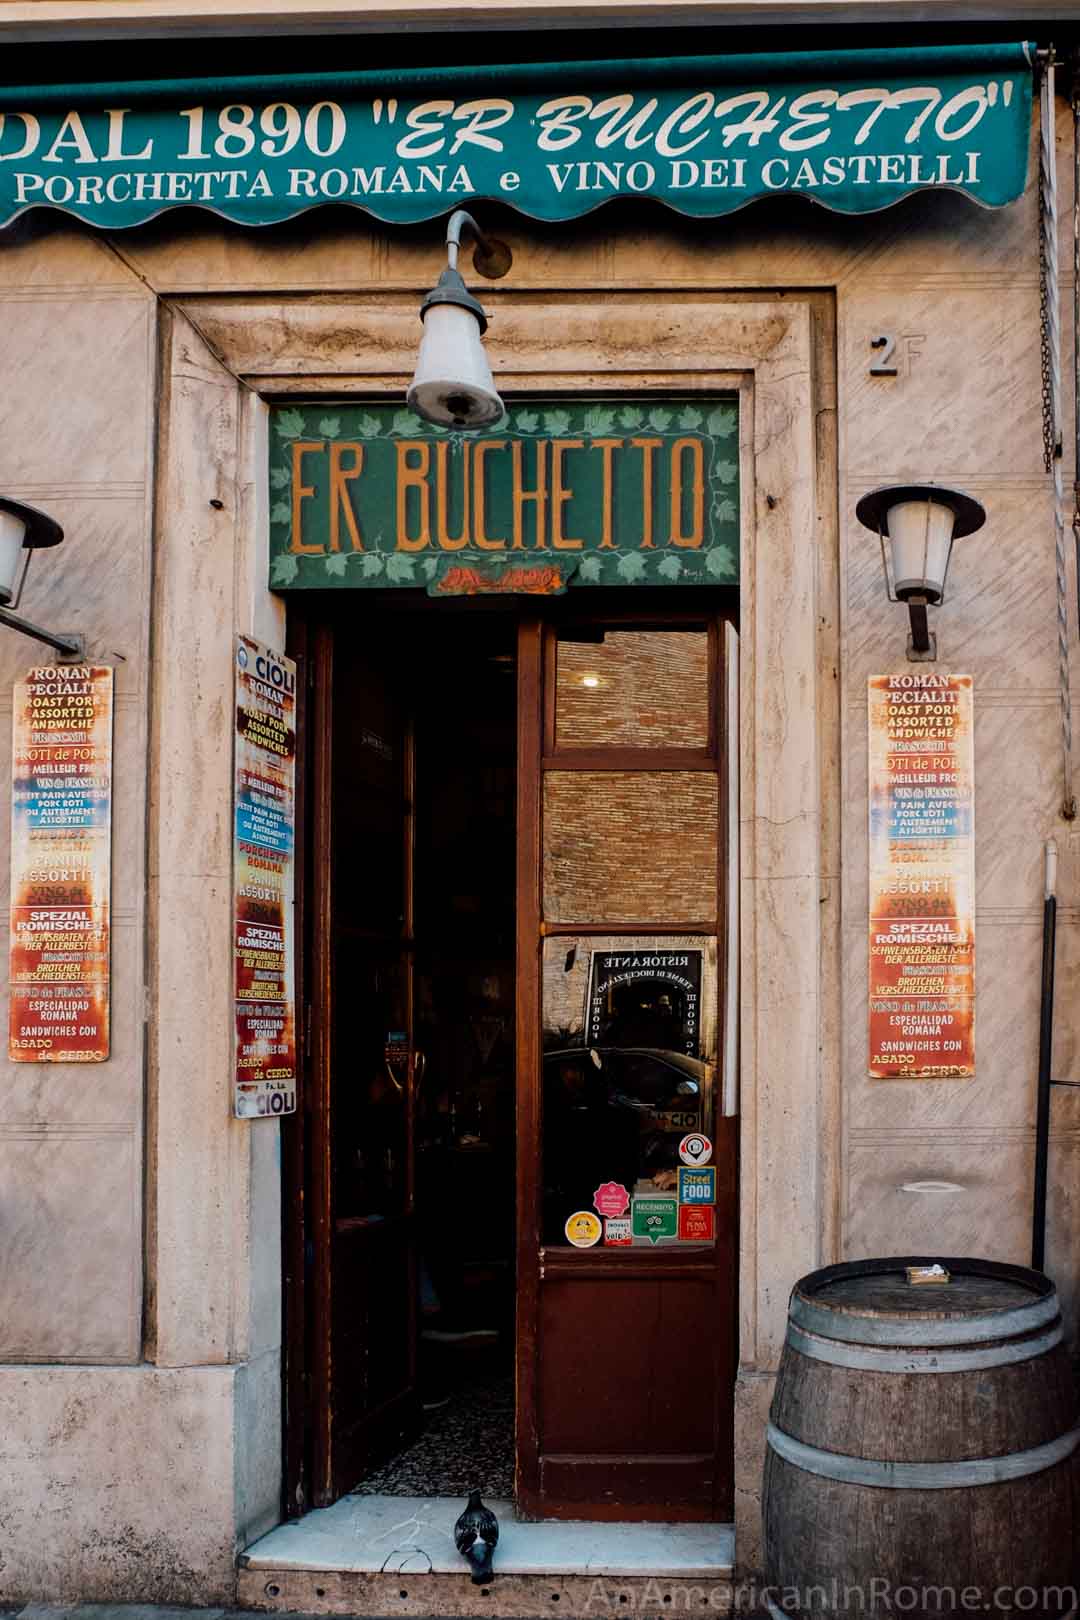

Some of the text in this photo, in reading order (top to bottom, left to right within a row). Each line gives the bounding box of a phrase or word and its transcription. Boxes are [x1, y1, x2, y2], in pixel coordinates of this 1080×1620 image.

[0, 108, 154, 163] DAL
[177, 101, 348, 159] 1890
[13, 153, 981, 204] PORCHETTA ROMANA e VINO DEI CASTELLI
[289, 438, 705, 553] ER BUCHETTO
[34, 667, 90, 680] ROMAN
[256, 656, 294, 693] CIOLI
[889, 675, 949, 688] ROMAN
[27, 683, 96, 695] PECIALIT
[249, 679, 284, 703] ROMAN
[883, 691, 956, 703] PECIALIT
[32, 708, 94, 718] ASSORTED
[31, 719, 96, 729] ANDWICHE
[888, 717, 954, 727] ASSORTED
[247, 720, 285, 743] ASSORTED
[888, 728, 957, 738] ANDWICHE
[243, 729, 289, 756] SANDWICHES
[54, 748, 70, 760] de
[887, 758, 909, 769] OTI
[912, 757, 929, 769] de
[33, 764, 77, 774] MEILLEUR
[889, 774, 937, 784] MEILLEUR
[42, 791, 65, 799] PAIN
[30, 911, 89, 921] SPEZIAL
[889, 924, 955, 933] SPEZIAL
[246, 928, 282, 941] SPEZIAL
[25, 942, 42, 951] DER
[885, 955, 903, 964] DER
[898, 977, 945, 986] BROTCHEN
[29, 1001, 89, 1010] ESPECIALIDAD
[40, 1011, 78, 1020] ROMANA
[889, 1015, 954, 1026] ESPECIALIDAD
[20, 1027, 97, 1036] SANDWICHES CON
[902, 1025, 942, 1036] ROMANA
[11, 1040, 52, 1048] ASADO
[880, 1040, 962, 1052] SANDWICHES CON
[872, 1054, 916, 1064] ASADO
[256, 1091, 295, 1115] CIOLI
[683, 1175, 711, 1185] Street
[683, 1185, 711, 1199] FOOD
